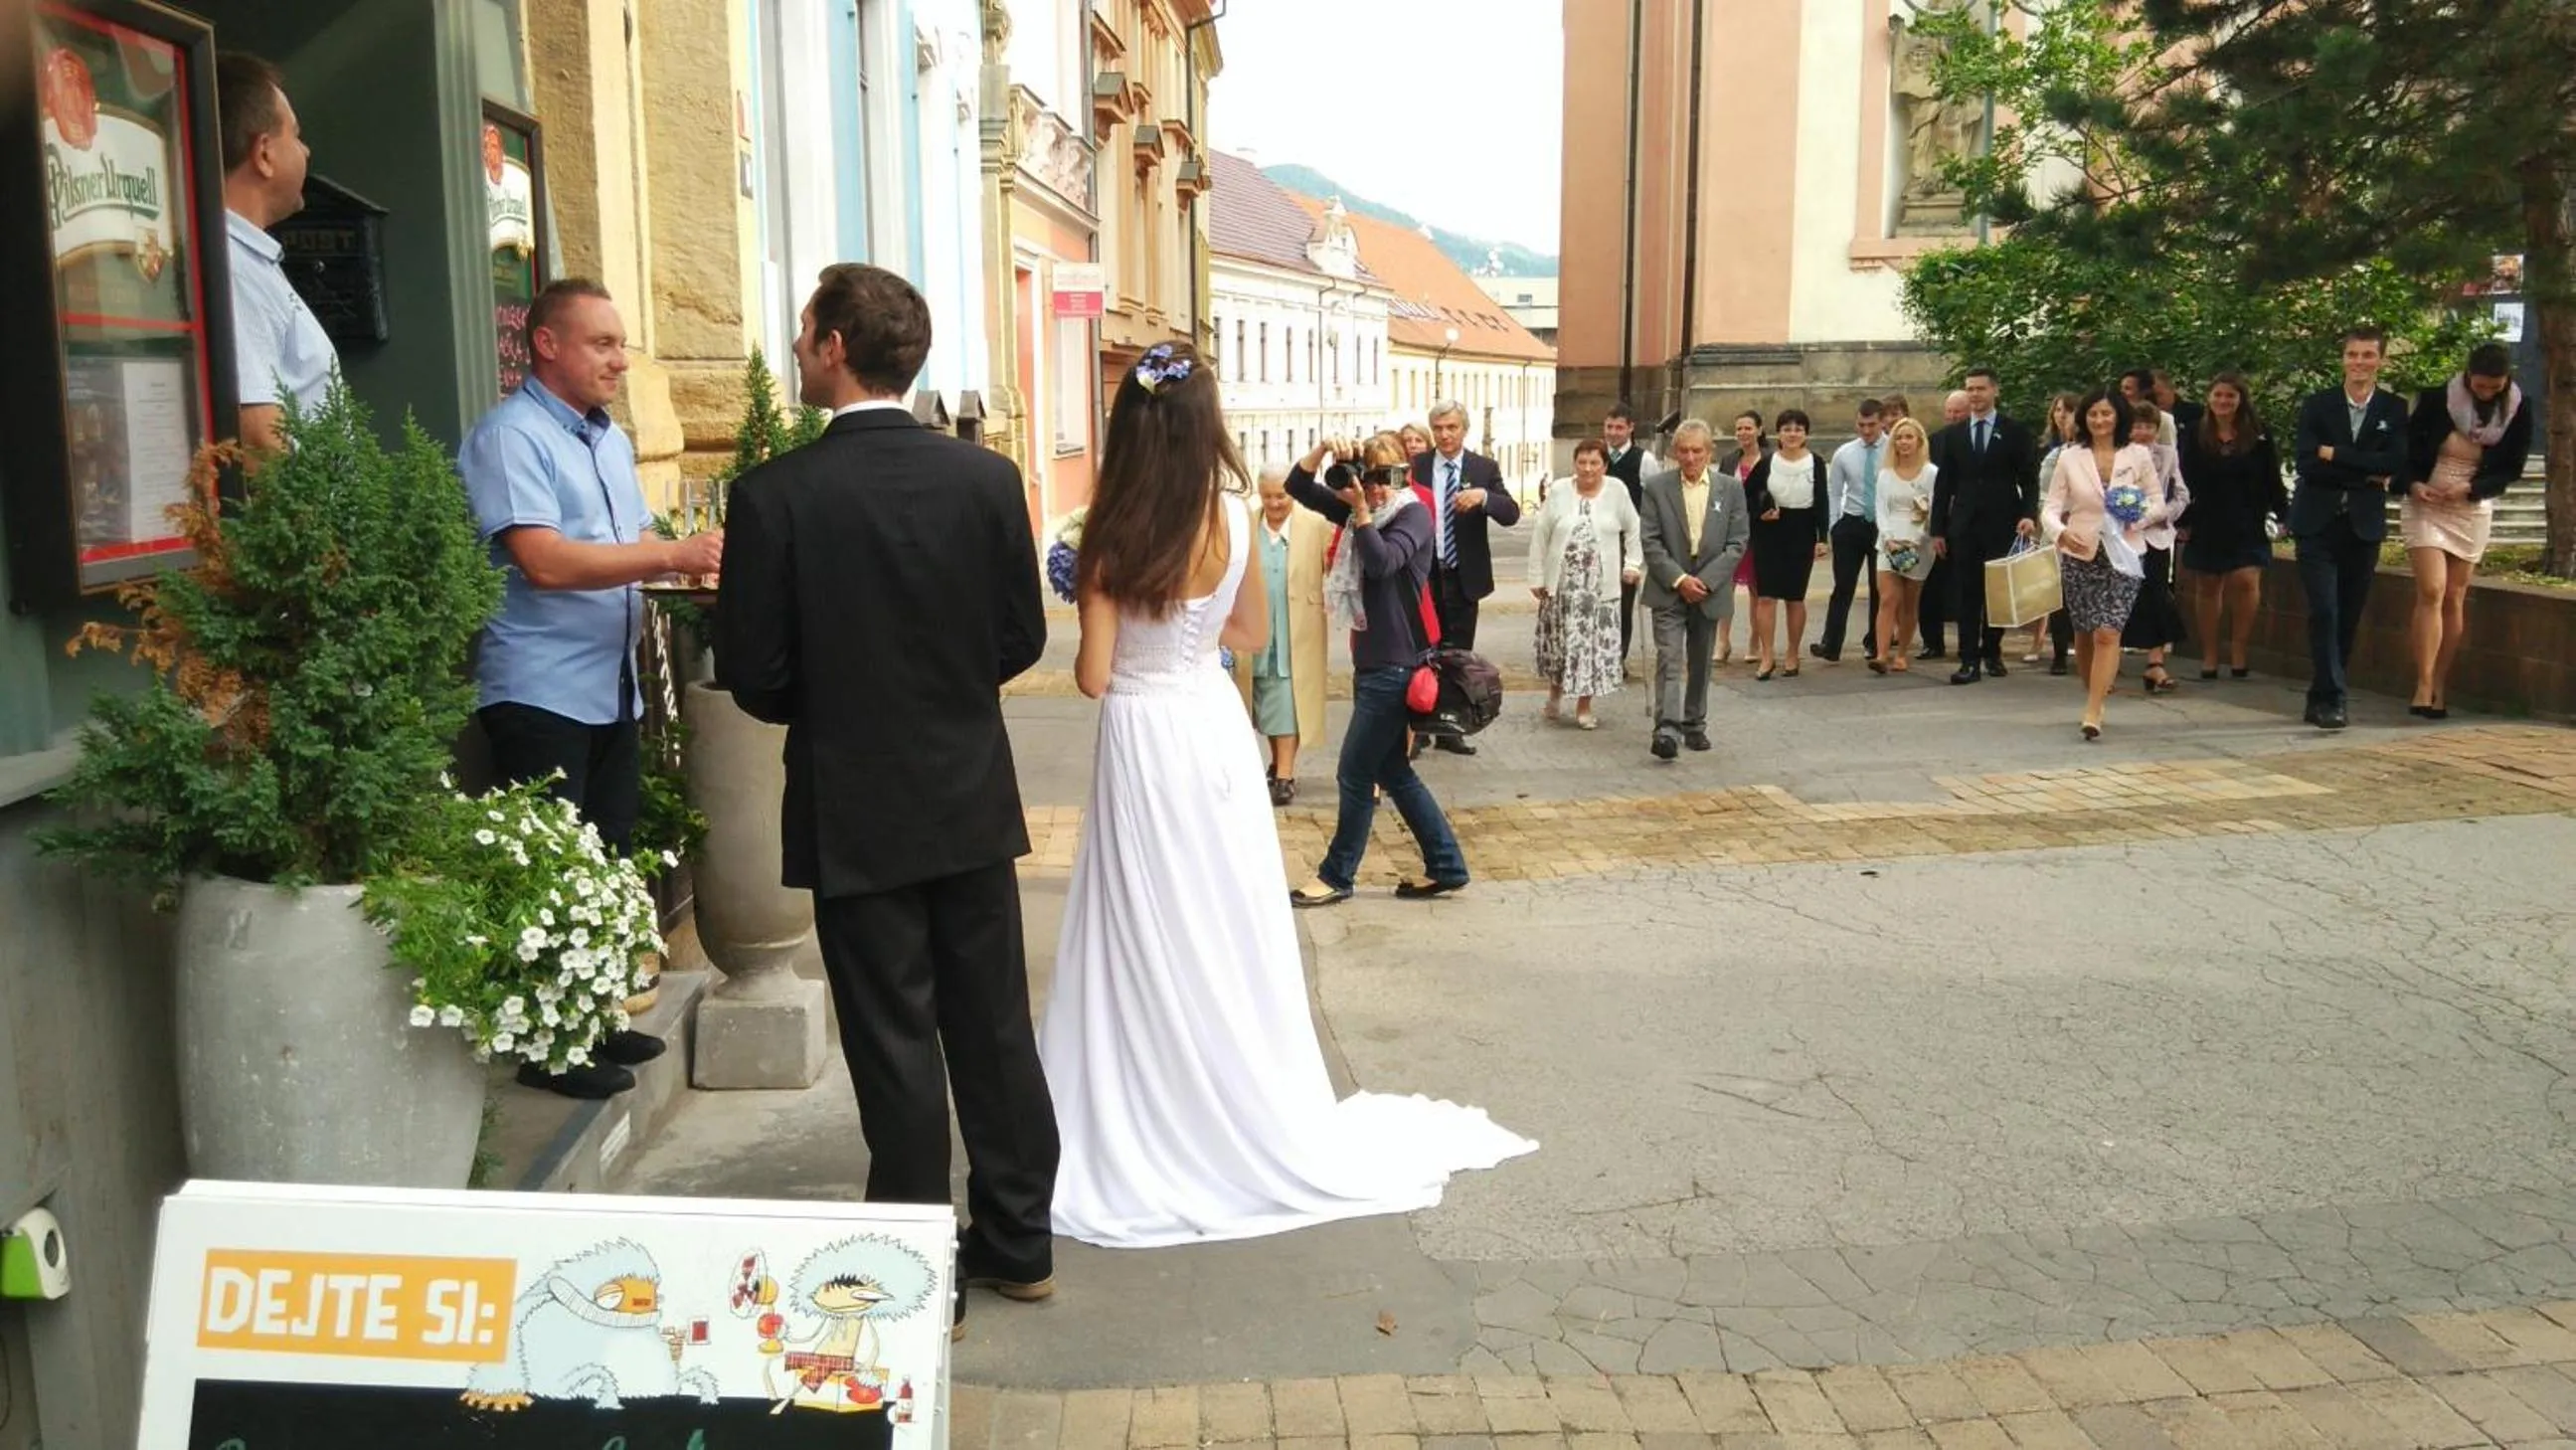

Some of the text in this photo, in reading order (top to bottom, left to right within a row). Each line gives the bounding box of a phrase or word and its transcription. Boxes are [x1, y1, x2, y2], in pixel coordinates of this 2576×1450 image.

[47, 143, 158, 230] Pilsner Urquell
[281, 230, 356, 250] POST
[206, 1266, 496, 1345] DEJTE SI:
